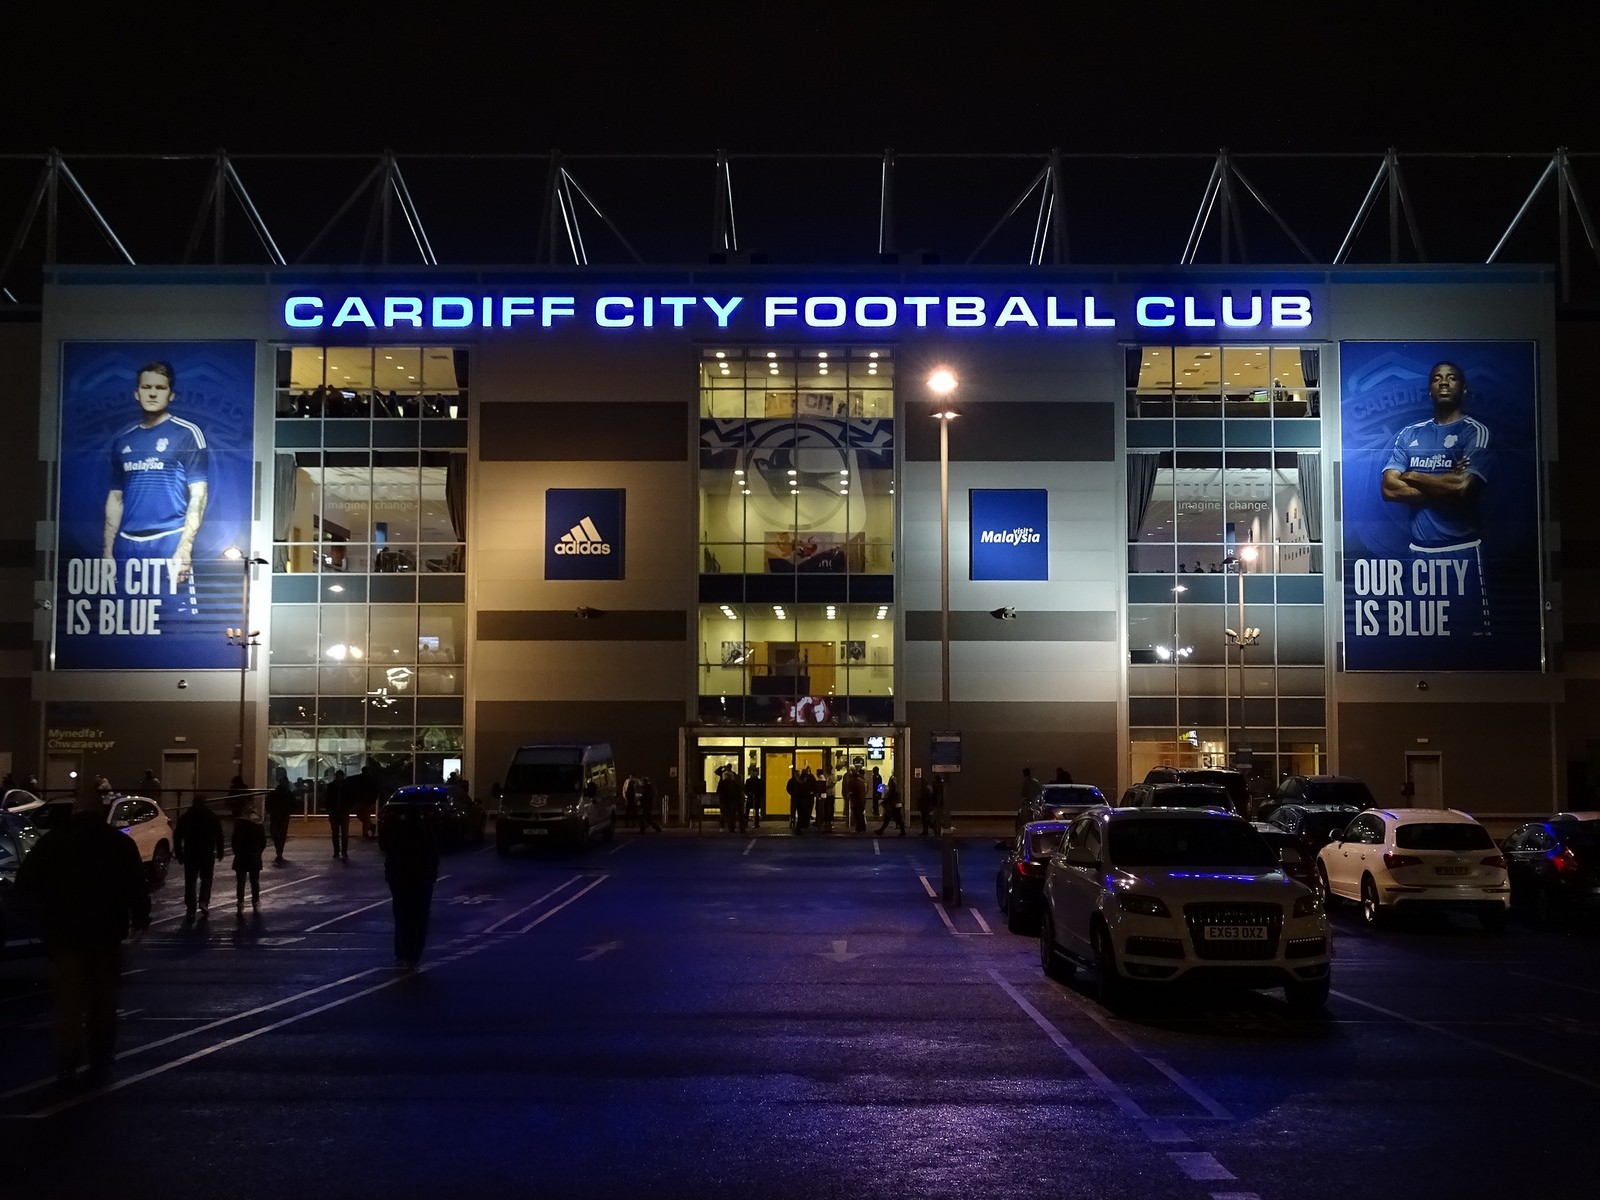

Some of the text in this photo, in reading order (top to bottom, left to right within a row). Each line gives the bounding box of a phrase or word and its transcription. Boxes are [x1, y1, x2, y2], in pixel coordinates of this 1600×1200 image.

[284, 296, 1313, 329] CARDIFF CITY FOOTBALL CLUB
[1350, 388, 1428, 420] CARDIF
[123, 460, 164, 472] Malaysia
[1410, 457, 1453, 470] Malaysia
[1229, 501, 1270, 512] change.
[981, 530, 1041, 546] Malaysia
[1013, 527, 1030, 536] visit
[554, 541, 611, 555] adidas
[67, 558, 182, 595] OUR CITY
[1354, 558, 1469, 596] OUR CITY
[66, 599, 162, 635] IS BLUE
[1355, 599, 1451, 636] IS BLUE
[48, 728, 105, 740] Mynedfa'r
[47, 739, 116, 751] Chwaraewyr
[1209, 927, 1264, 938] EX63 OXZ
